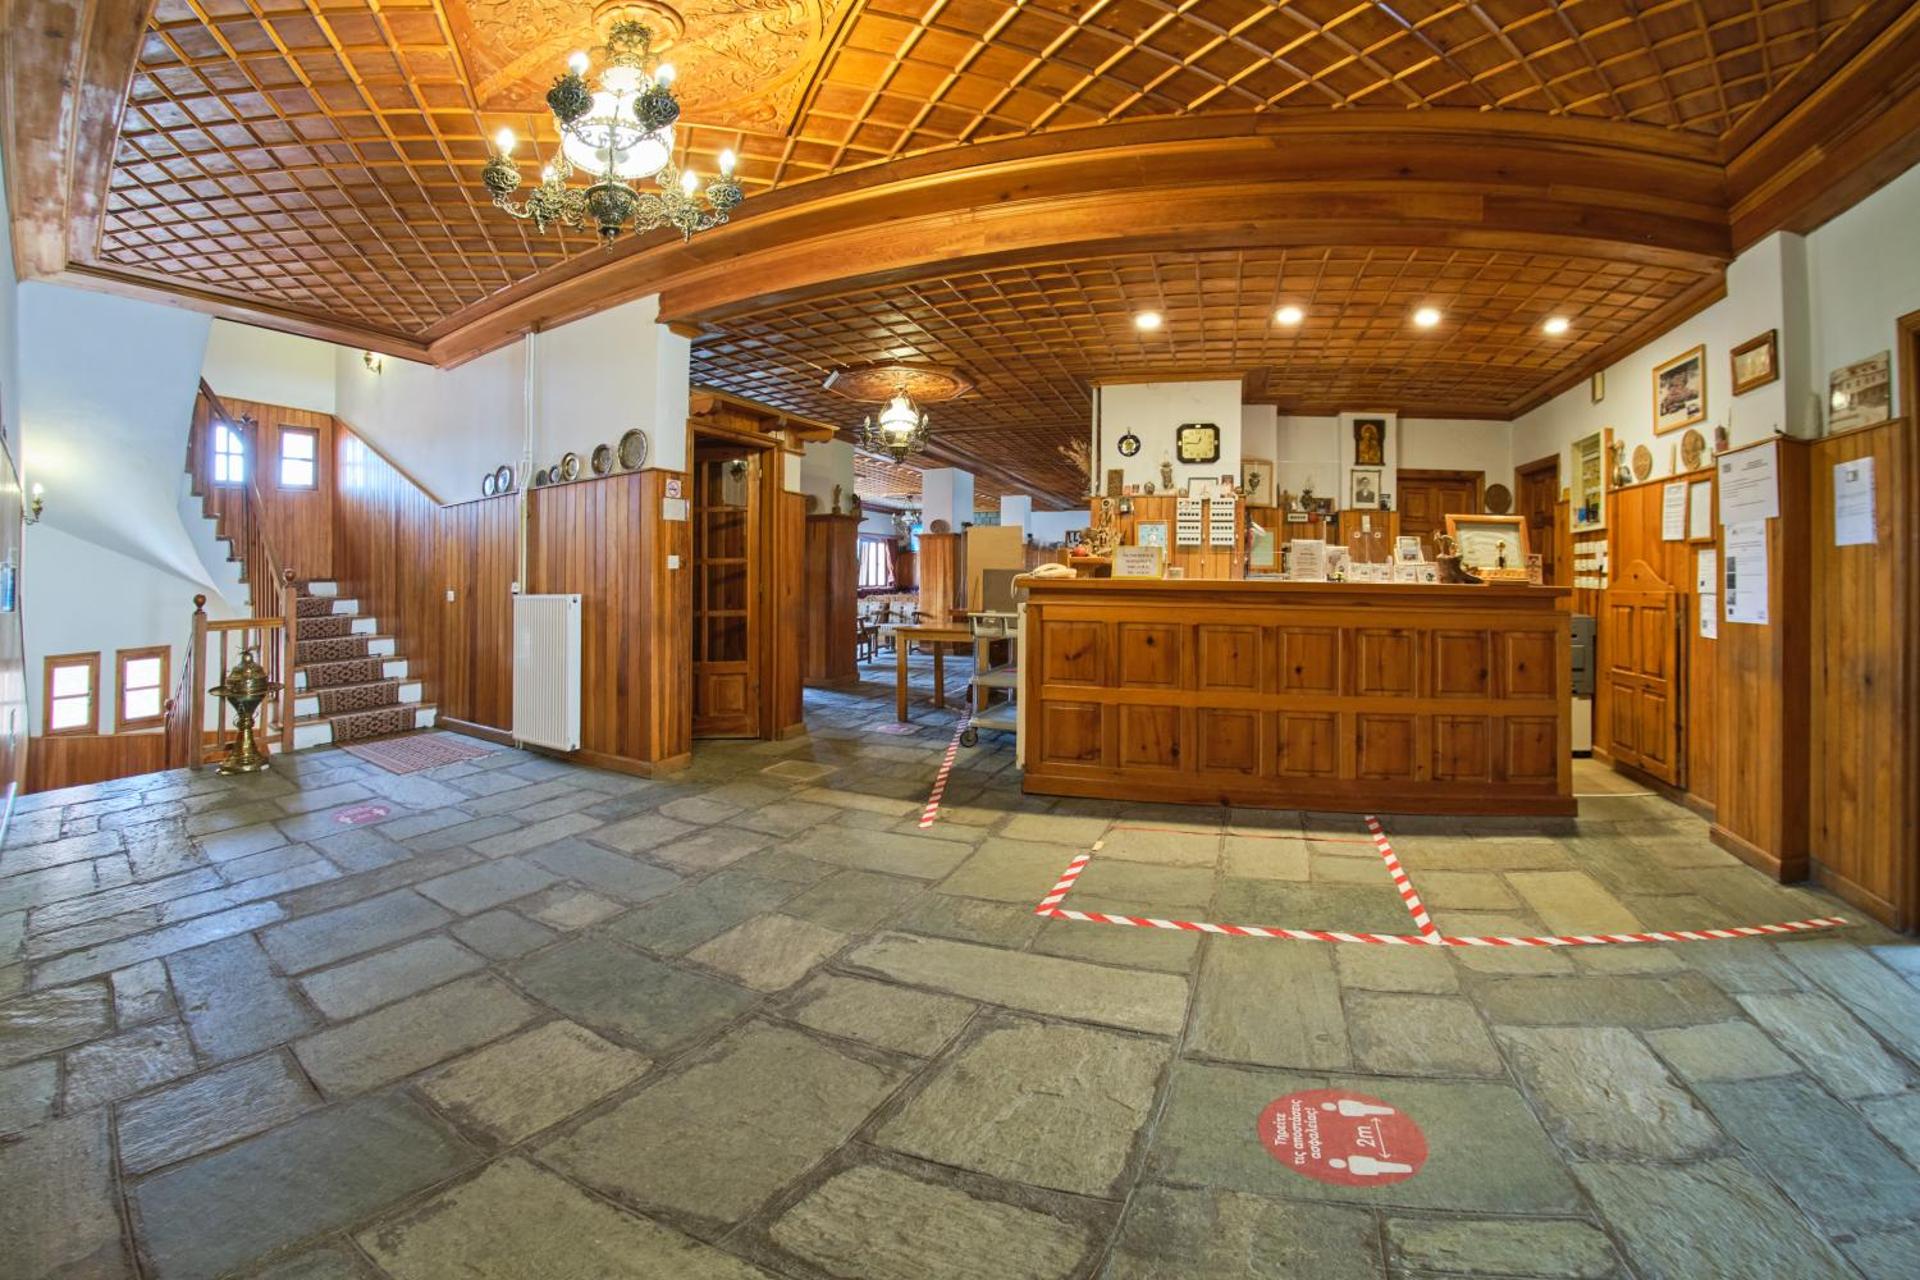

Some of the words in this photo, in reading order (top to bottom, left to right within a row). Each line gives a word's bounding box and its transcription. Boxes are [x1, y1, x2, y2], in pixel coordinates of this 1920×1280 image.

[1273, 1112, 1289, 1146] Τηρείτε
[1288, 1099, 1304, 1149] αποστάσεις
[1304, 1107, 1322, 1159] ασφαλείας!
[1356, 1125, 1377, 1148] 2m
[1294, 1149, 1307, 1165] τις
